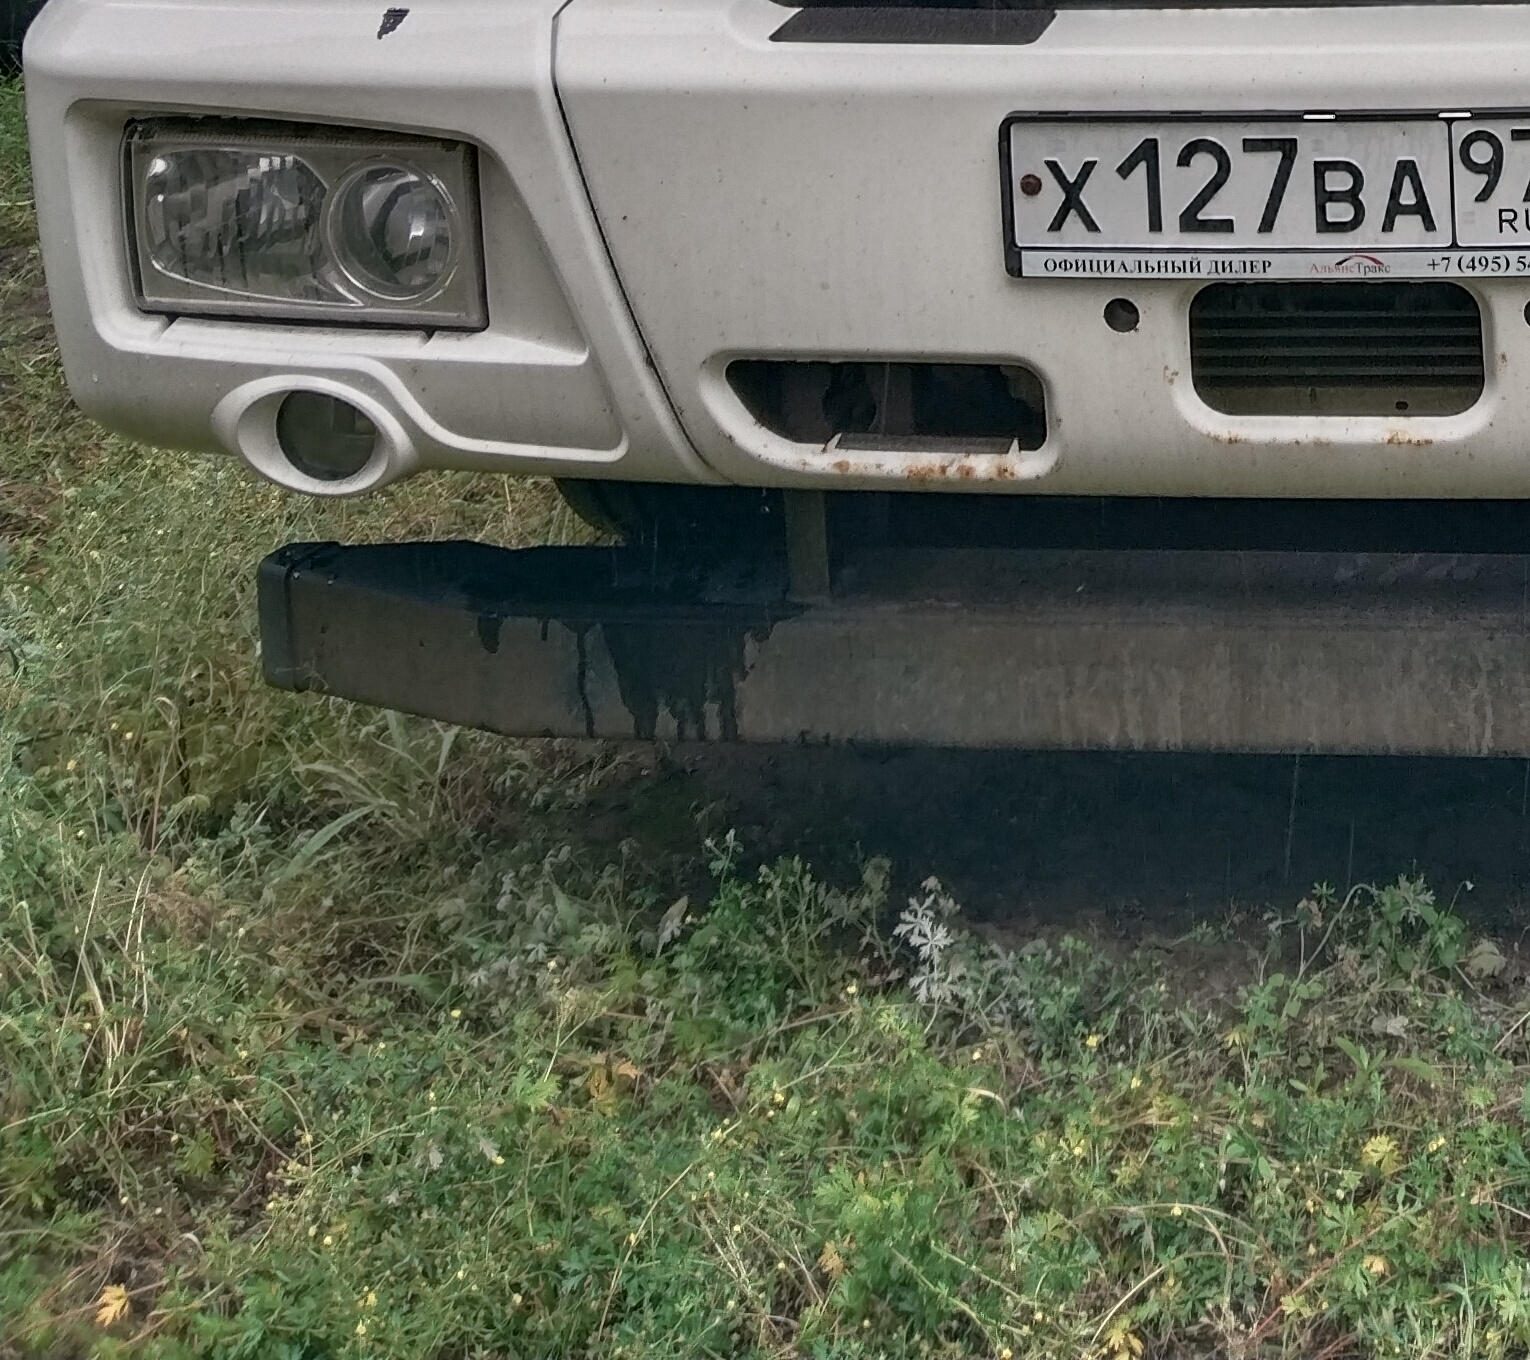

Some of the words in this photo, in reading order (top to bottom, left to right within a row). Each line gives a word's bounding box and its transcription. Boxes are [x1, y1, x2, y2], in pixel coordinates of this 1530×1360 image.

[1044, 256, 1201, 275] ОФИЦИАЛЬНЫЙ
[1207, 260, 1272, 276] ДИЛЕР
[1427, 256, 1451, 273] +7
[1457, 254, 1511, 274] (495)
